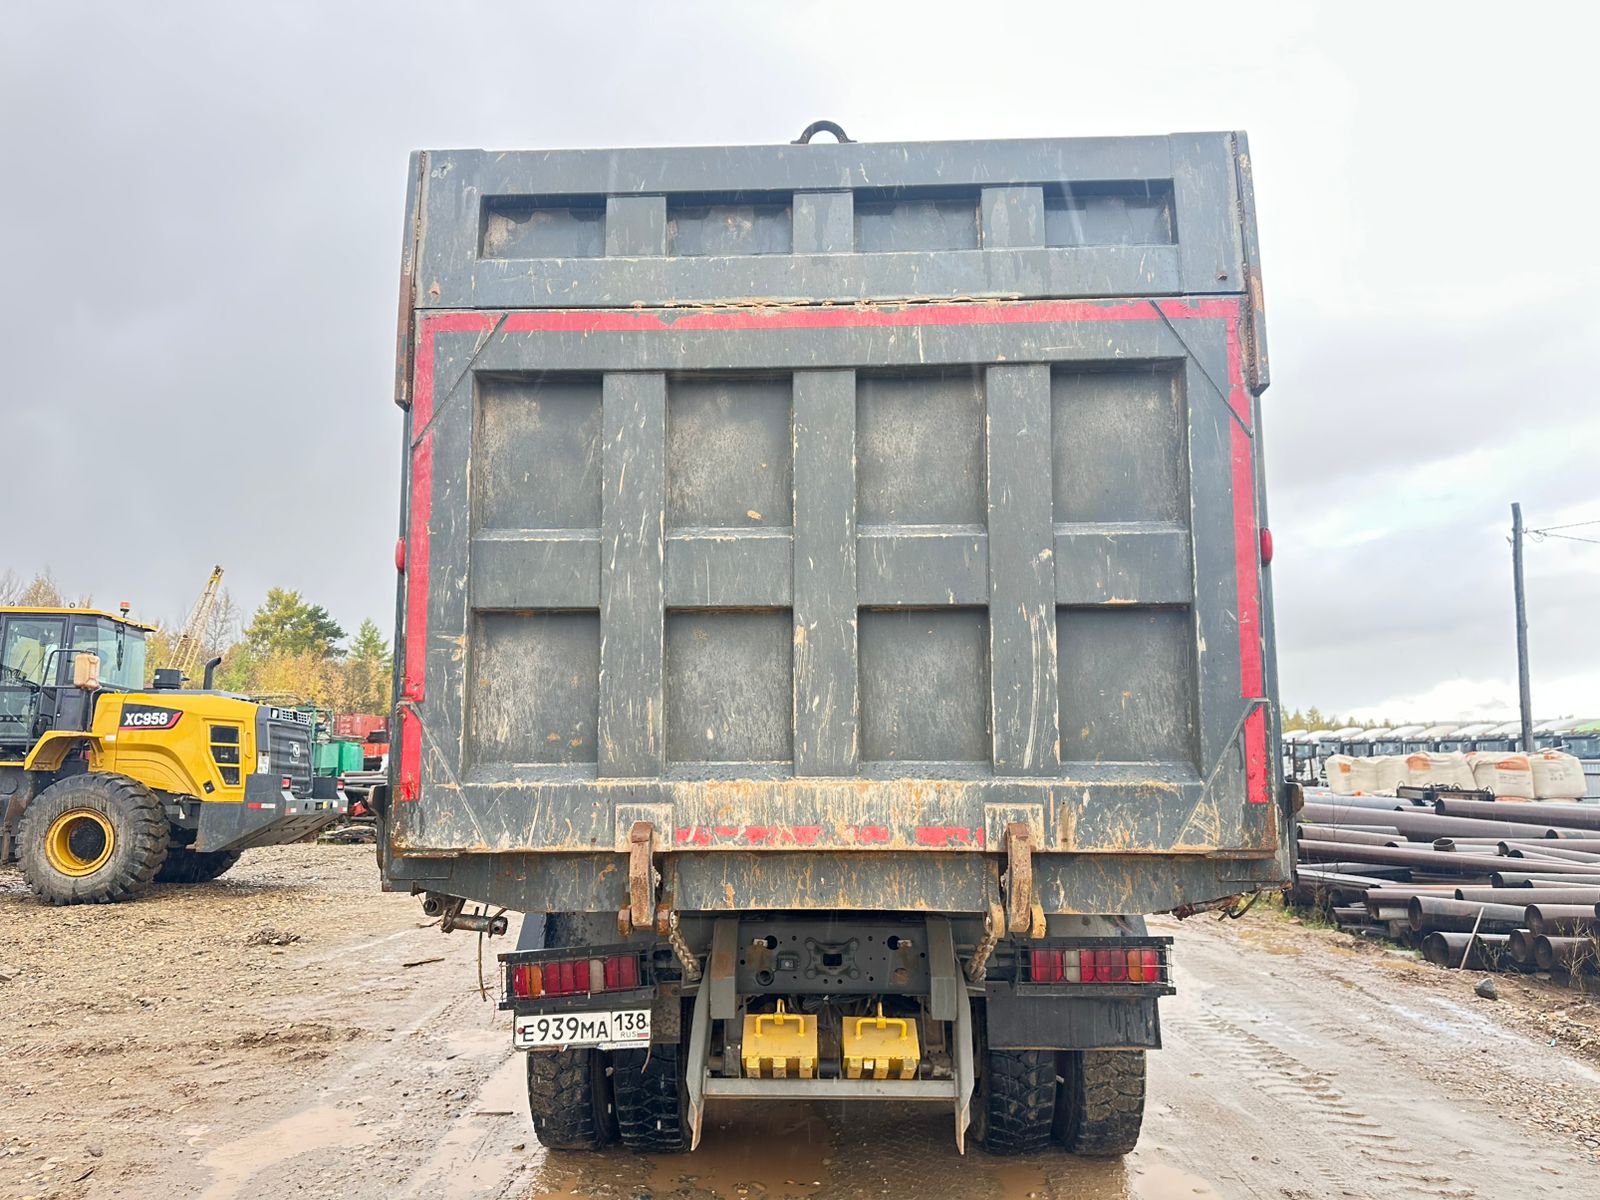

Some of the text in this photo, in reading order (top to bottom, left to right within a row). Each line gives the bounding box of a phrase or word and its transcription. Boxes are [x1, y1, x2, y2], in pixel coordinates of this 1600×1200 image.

[124, 712, 168, 726] XC958
[614, 1012, 647, 1031] 138
[620, 1030, 637, 1039] RUS
